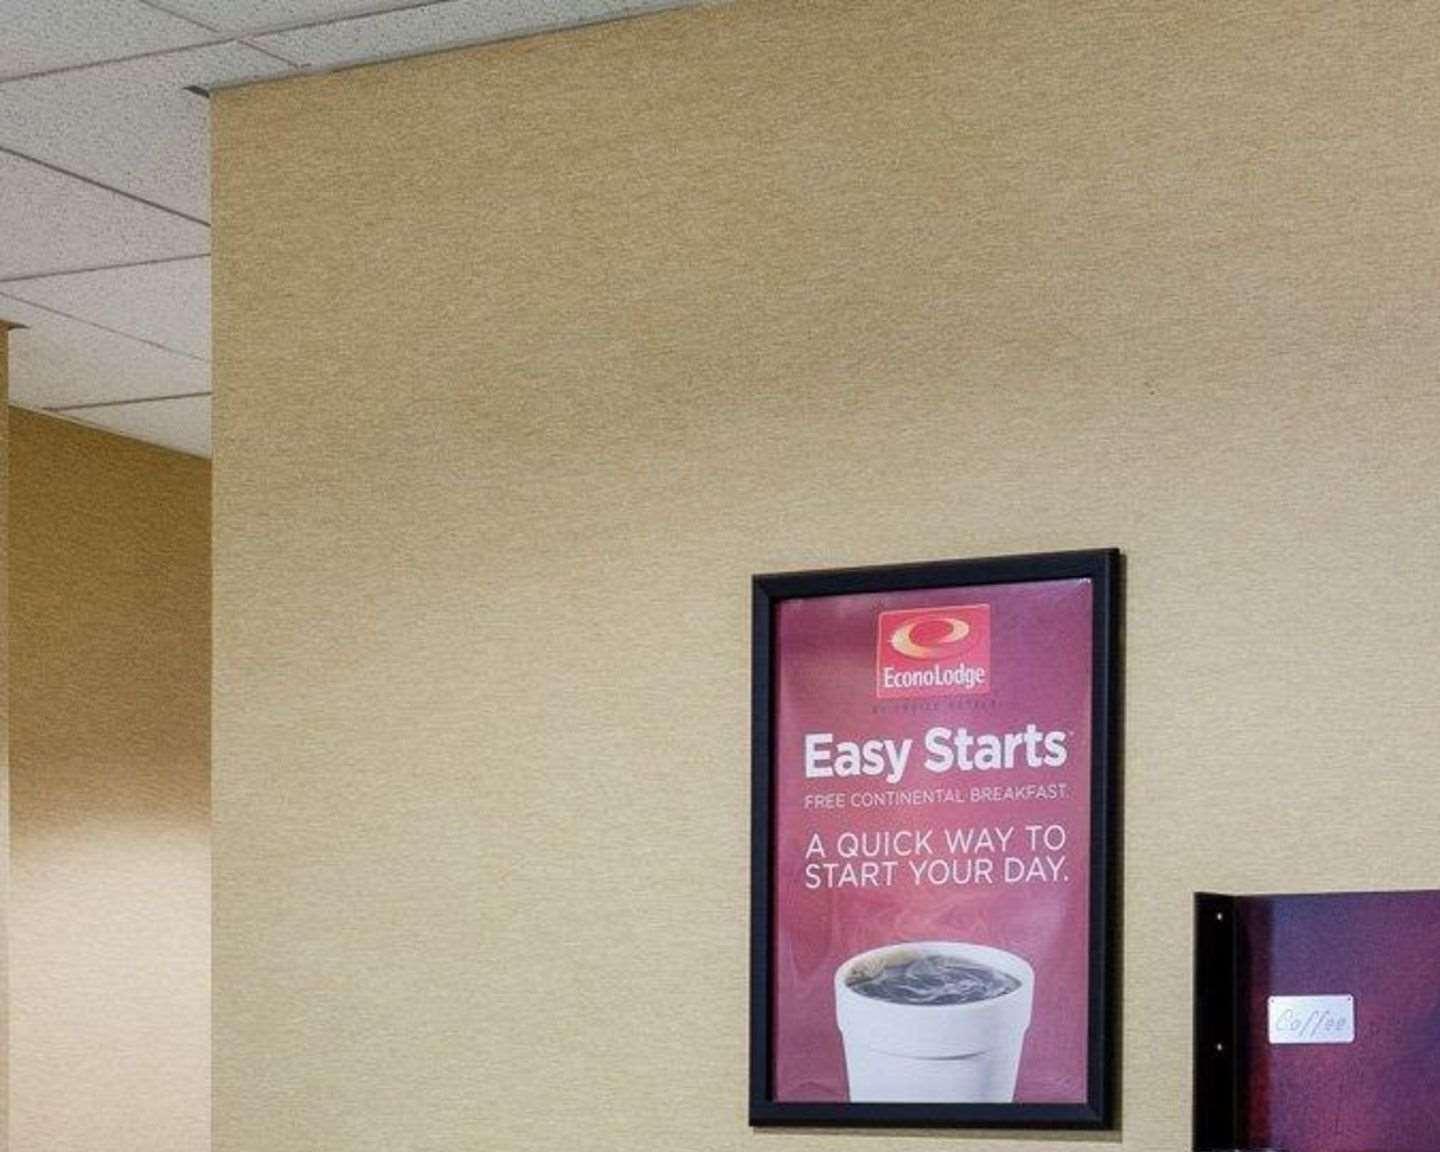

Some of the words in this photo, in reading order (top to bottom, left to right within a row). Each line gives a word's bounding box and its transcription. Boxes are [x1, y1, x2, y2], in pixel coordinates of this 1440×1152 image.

[883, 662, 985, 690] EconoLodge
[805, 733, 913, 783] Easy
[924, 724, 1067, 773] Starts
[804, 793, 846, 809] FREE
[850, 784, 965, 808] CONTINENTAL
[805, 833, 826, 858] A
[837, 829, 933, 858] QUICK
[944, 826, 1014, 853] WAY
[1026, 824, 1066, 851] TO
[805, 860, 898, 889] START
[909, 857, 993, 886] YOUR
[1003, 855, 1069, 883] DAY.
[1276, 1008, 1347, 1037] Coffee
